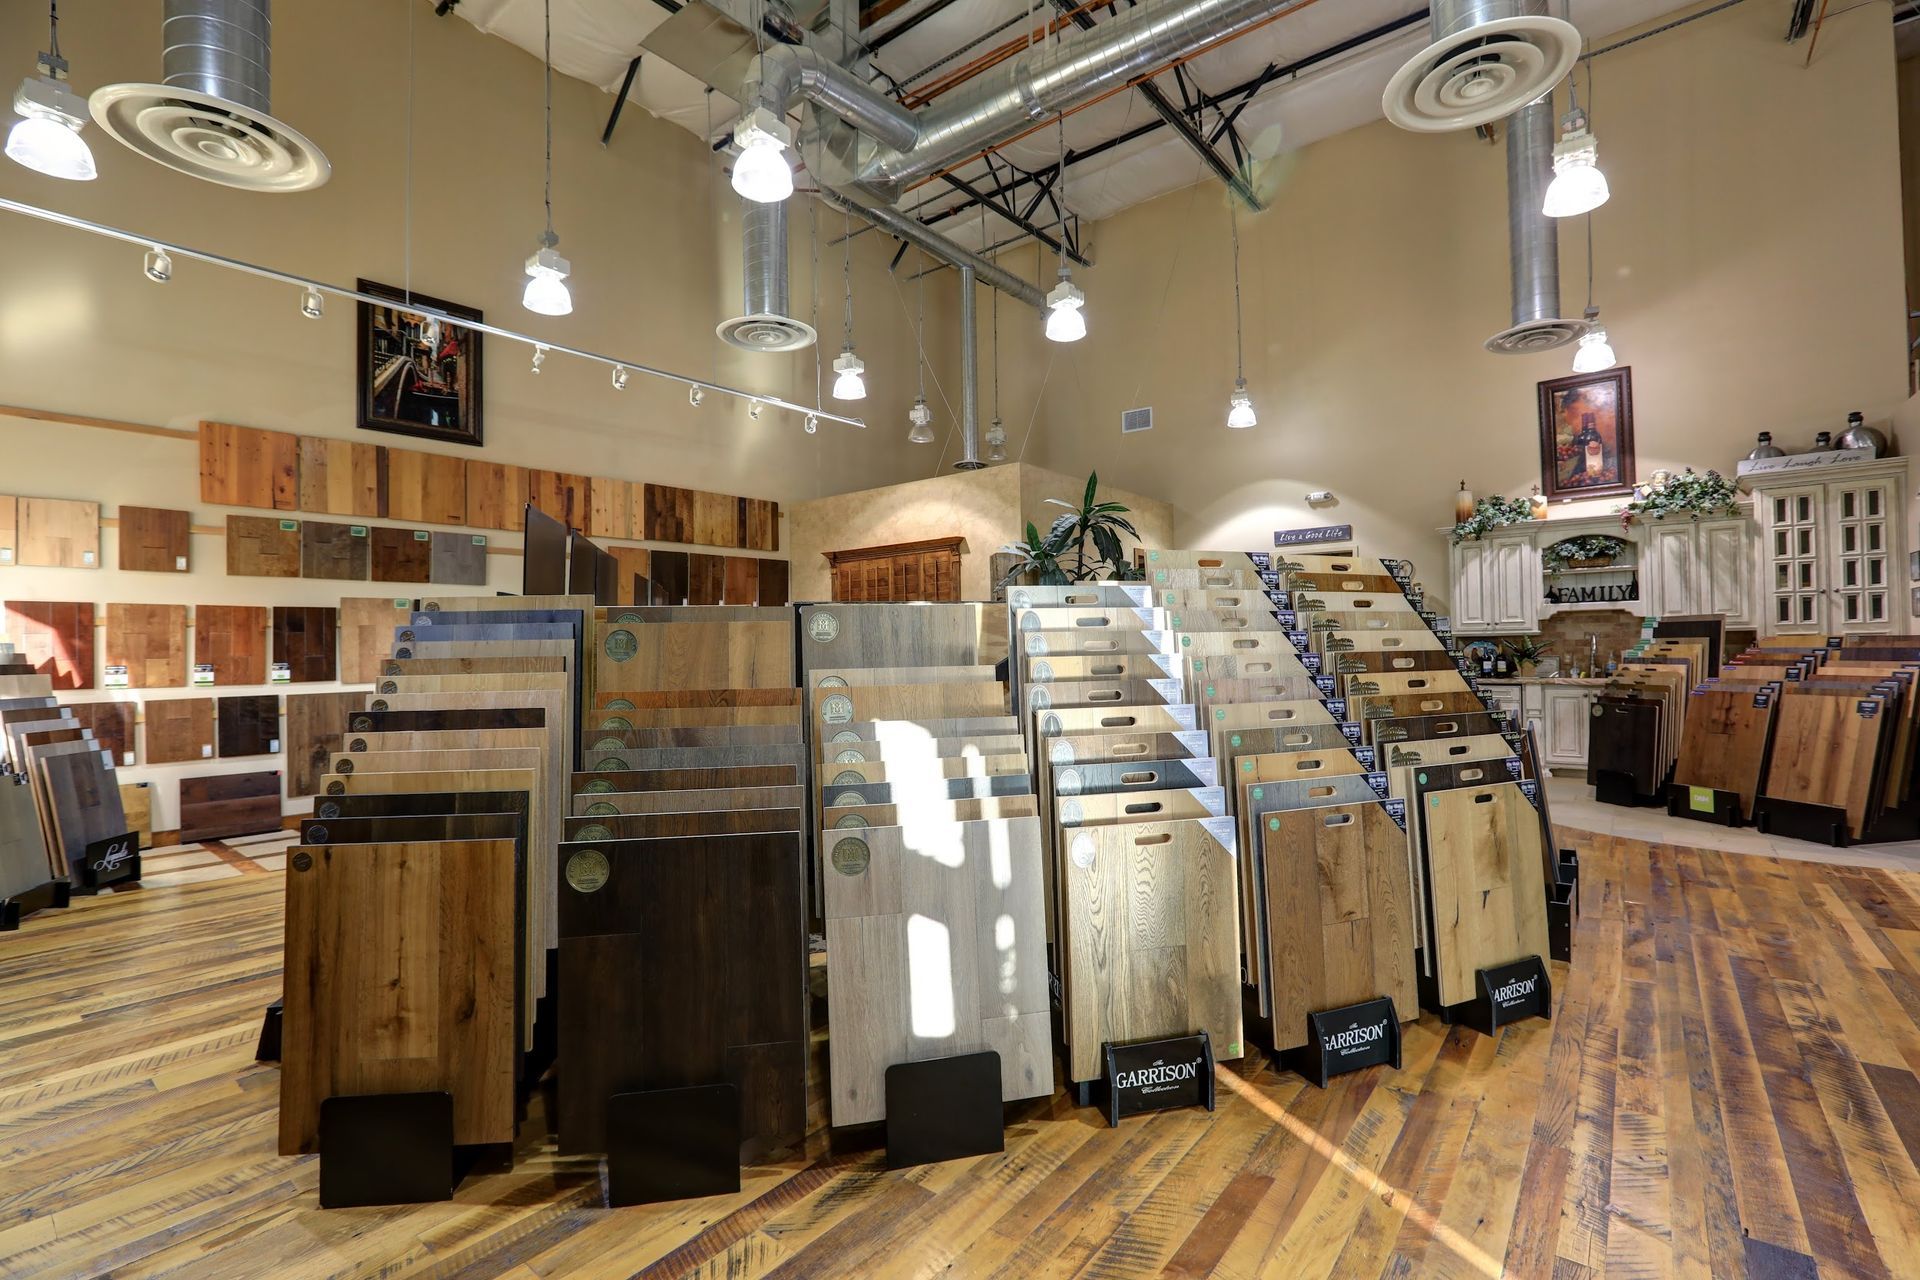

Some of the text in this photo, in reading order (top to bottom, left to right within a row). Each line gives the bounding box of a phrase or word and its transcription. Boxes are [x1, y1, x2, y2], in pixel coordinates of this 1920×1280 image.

[1748, 453, 1861, 472] Live Laugh Love
[1305, 530, 1323, 539] Good
[1557, 585, 1632, 603] FAMILY
[1491, 979, 1535, 1002] ARRISON
[1116, 1061, 1197, 1089] GARRISON
